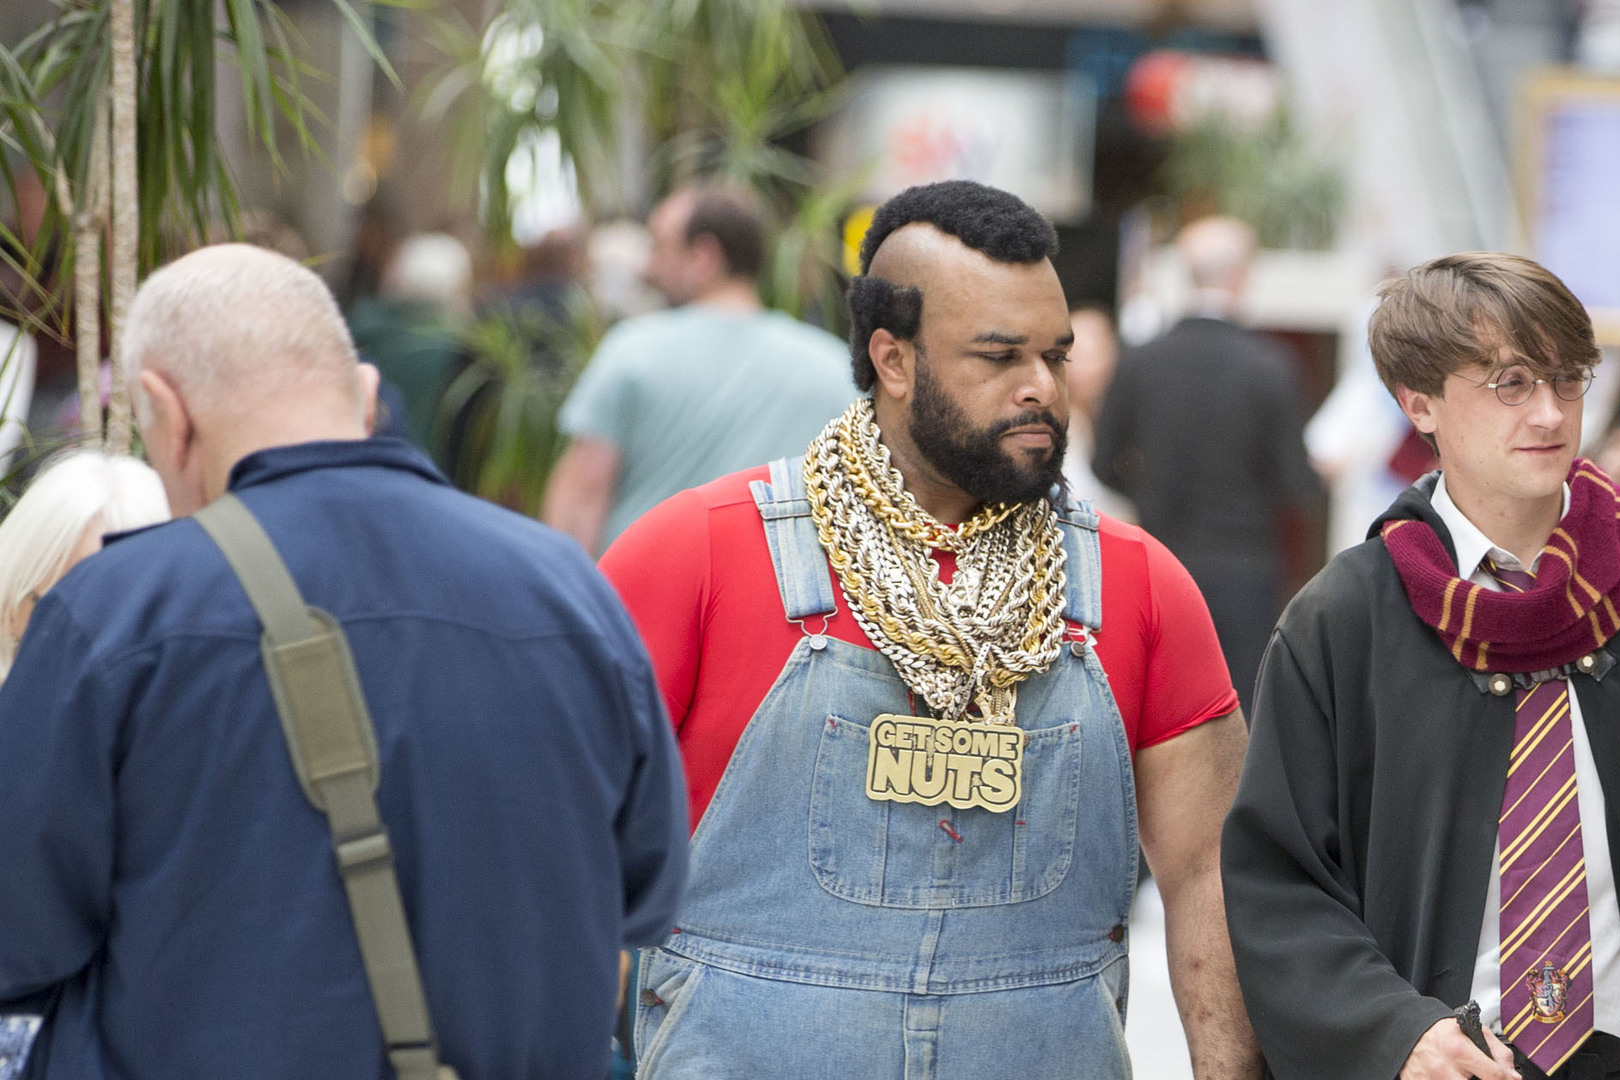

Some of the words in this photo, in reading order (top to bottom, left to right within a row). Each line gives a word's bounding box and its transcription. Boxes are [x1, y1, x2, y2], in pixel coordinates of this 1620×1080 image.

[876, 721, 934, 750] GET
[934, 726, 1019, 760] SOME
[872, 746, 1017, 805] NUTS
